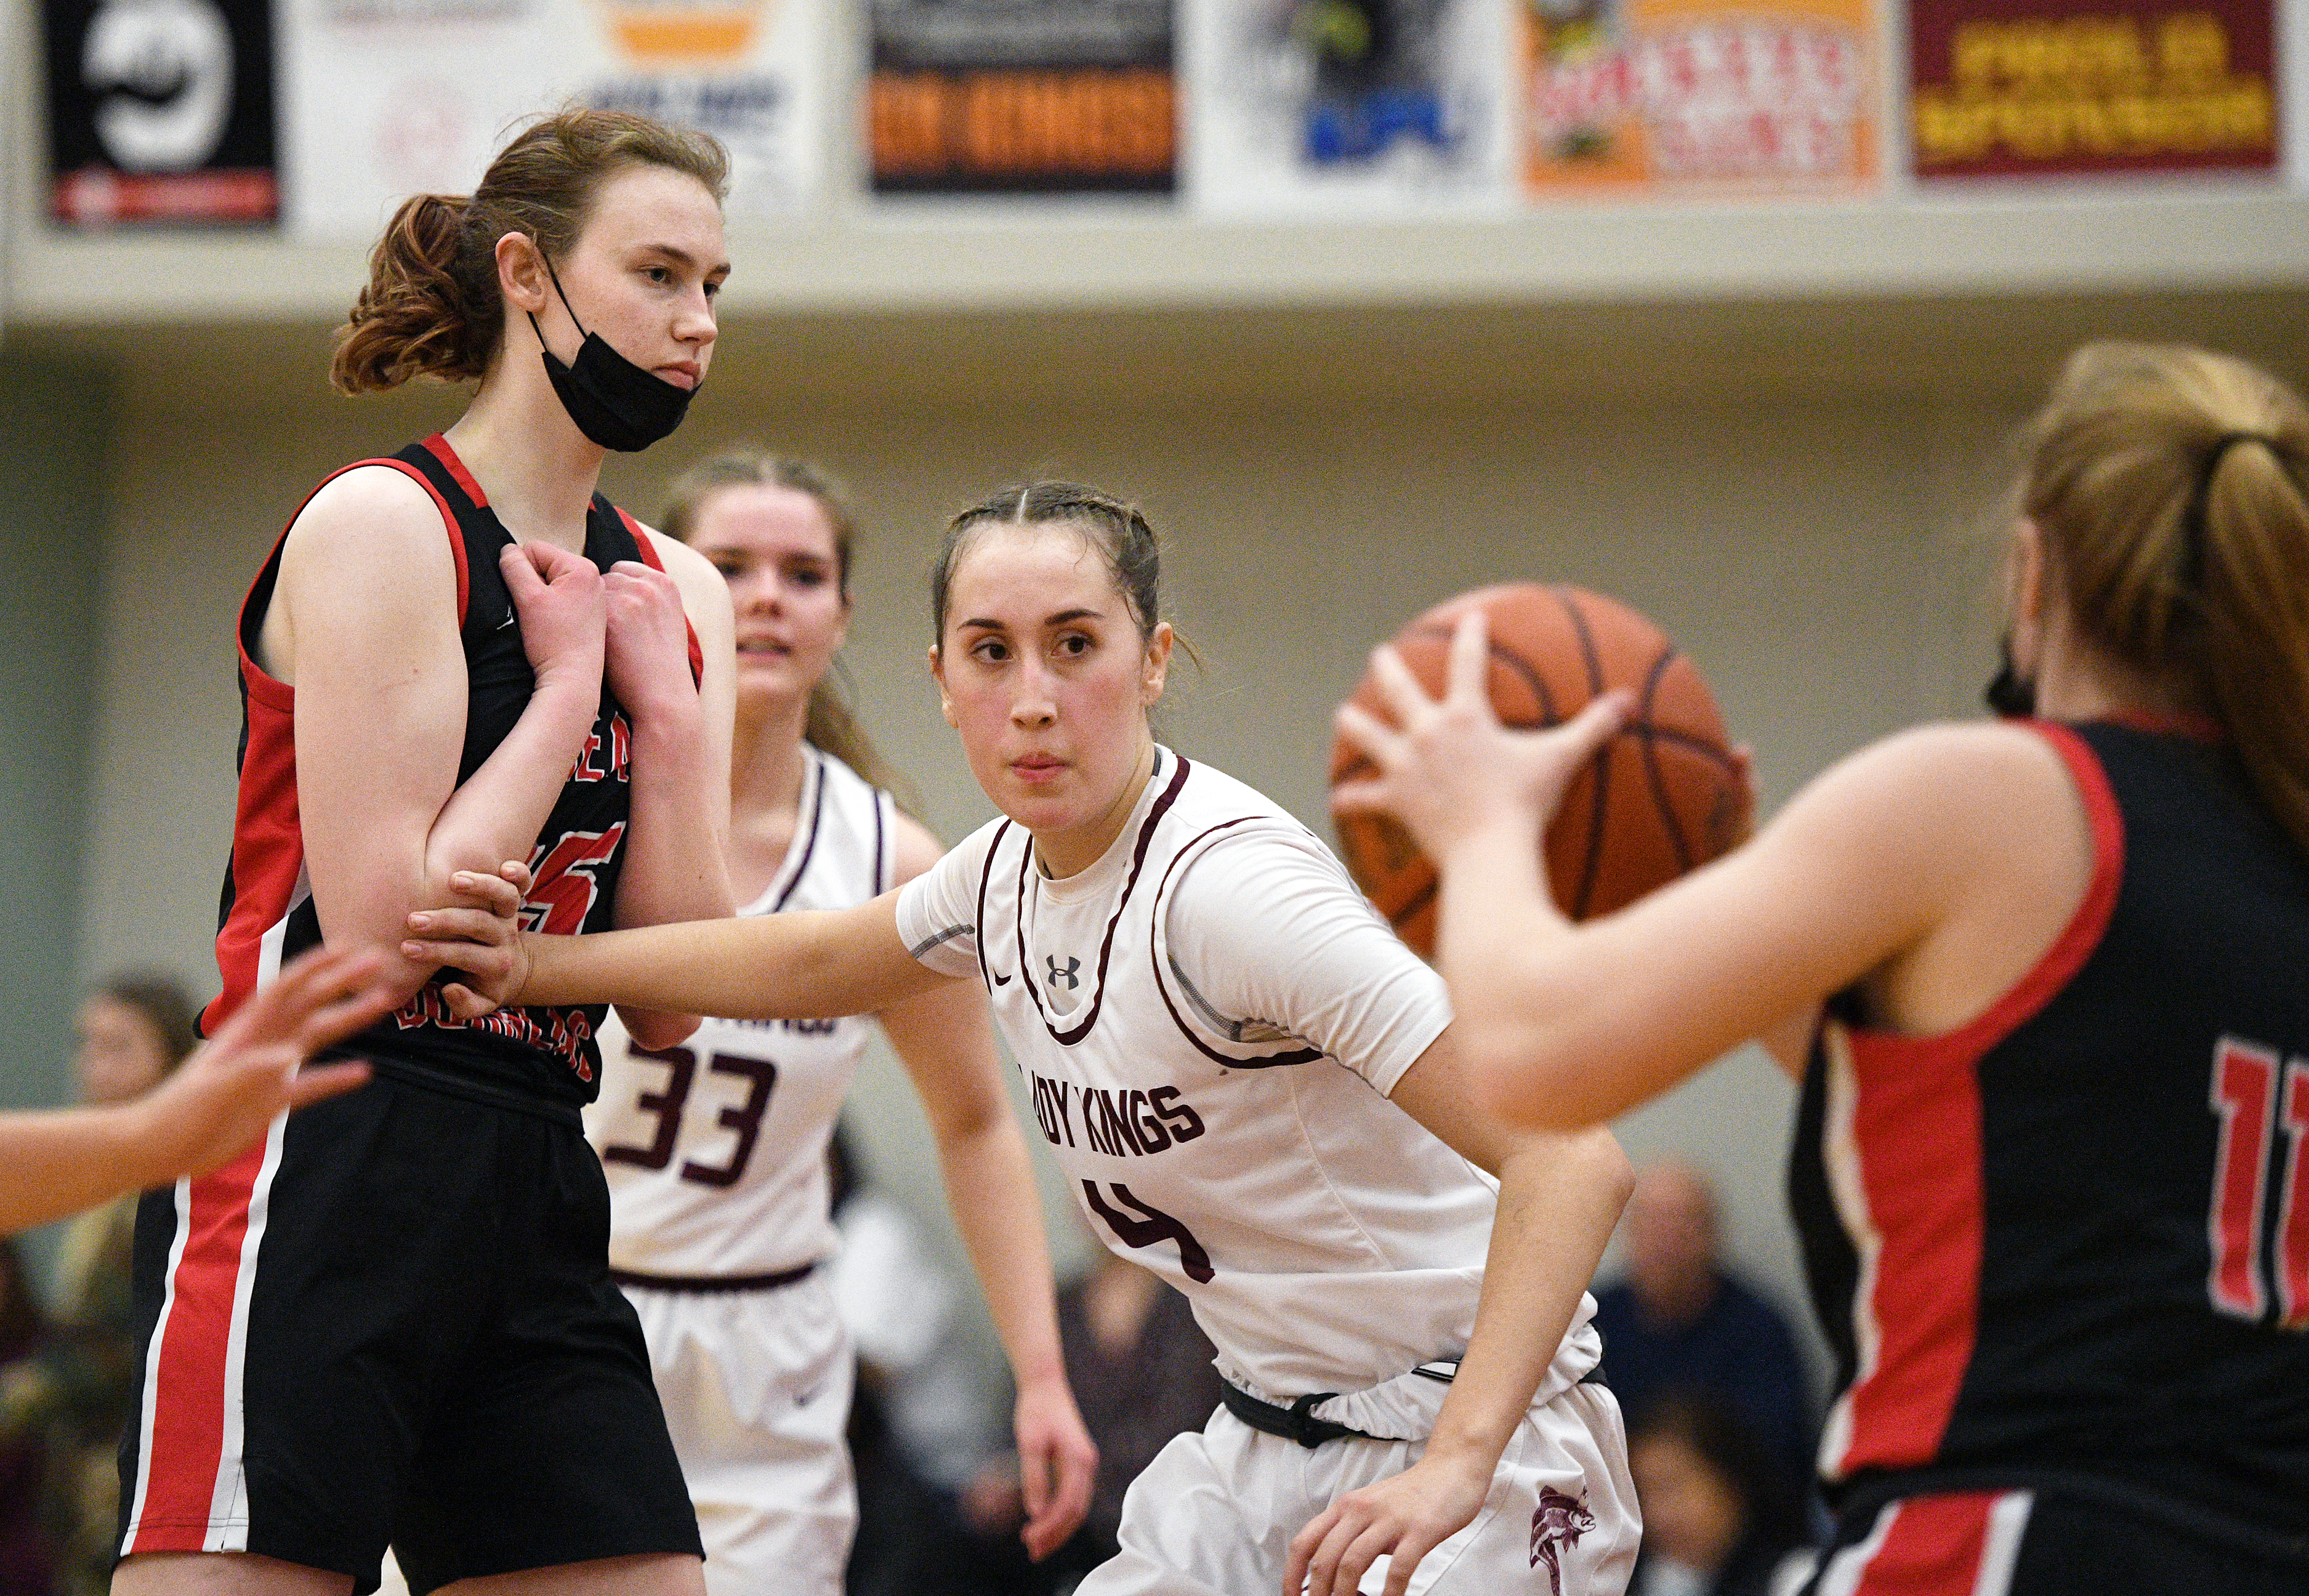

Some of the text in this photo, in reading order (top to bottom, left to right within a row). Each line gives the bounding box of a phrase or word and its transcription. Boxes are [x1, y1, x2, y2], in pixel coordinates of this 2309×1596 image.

[605, 1039, 776, 1188] 33
[1074, 1085, 1206, 1158] KINGS
[1081, 1179, 1215, 1284] 4
